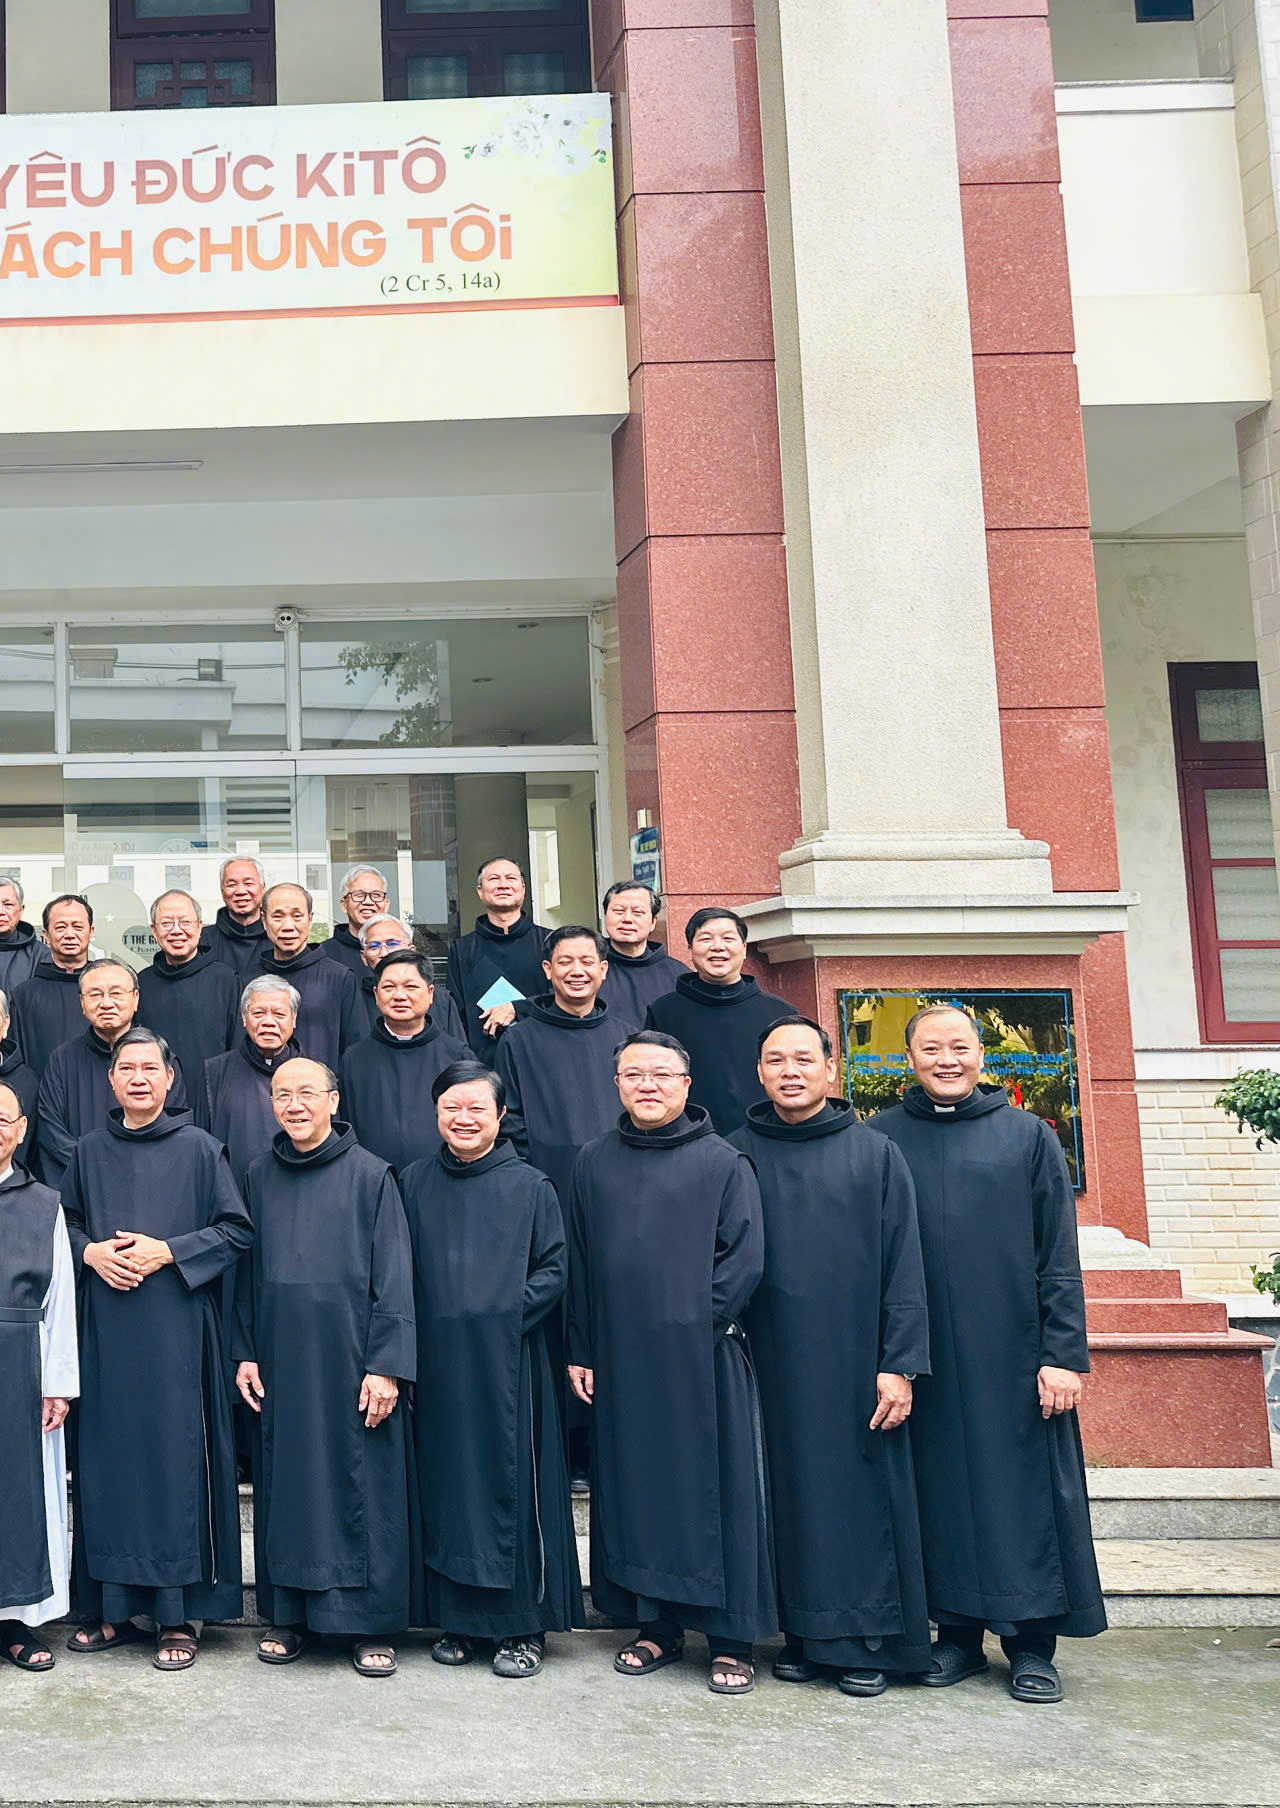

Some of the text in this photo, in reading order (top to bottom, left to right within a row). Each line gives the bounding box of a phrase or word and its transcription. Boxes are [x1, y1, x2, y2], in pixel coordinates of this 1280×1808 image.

[130, 144, 276, 206] ĐỨC
[152, 211, 387, 276] CHÚNG
[380, 271, 502, 297] (2 Cr 5, 14a)
[130, 935, 146, 945] THE
